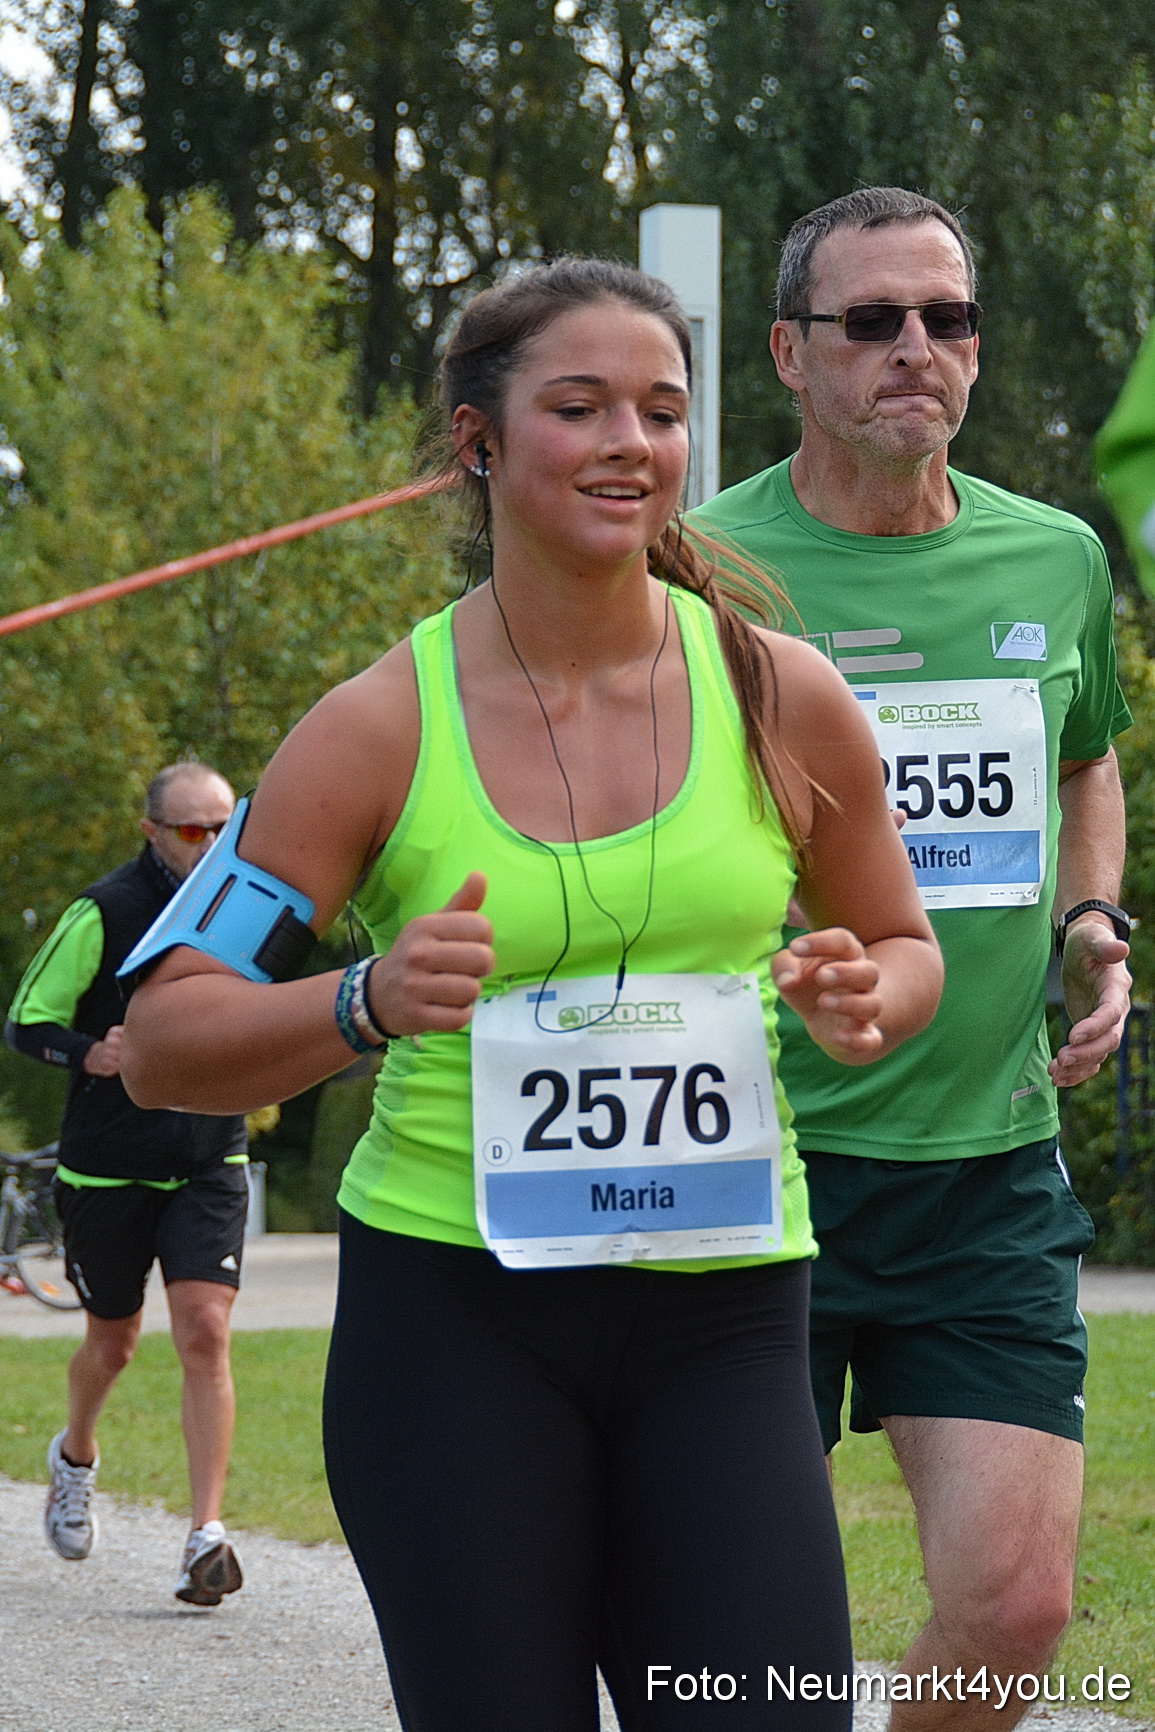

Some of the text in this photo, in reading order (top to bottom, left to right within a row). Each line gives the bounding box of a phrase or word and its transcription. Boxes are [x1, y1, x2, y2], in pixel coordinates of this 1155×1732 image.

[1011, 626, 1043, 642] AOK
[901, 703, 980, 722] BOCK
[908, 844, 971, 868] Alfred
[587, 1002, 684, 1026] BOCK
[520, 1063, 731, 1152] 2576
[492, 1146, 503, 1159] D
[591, 1181, 675, 1212] Maria
